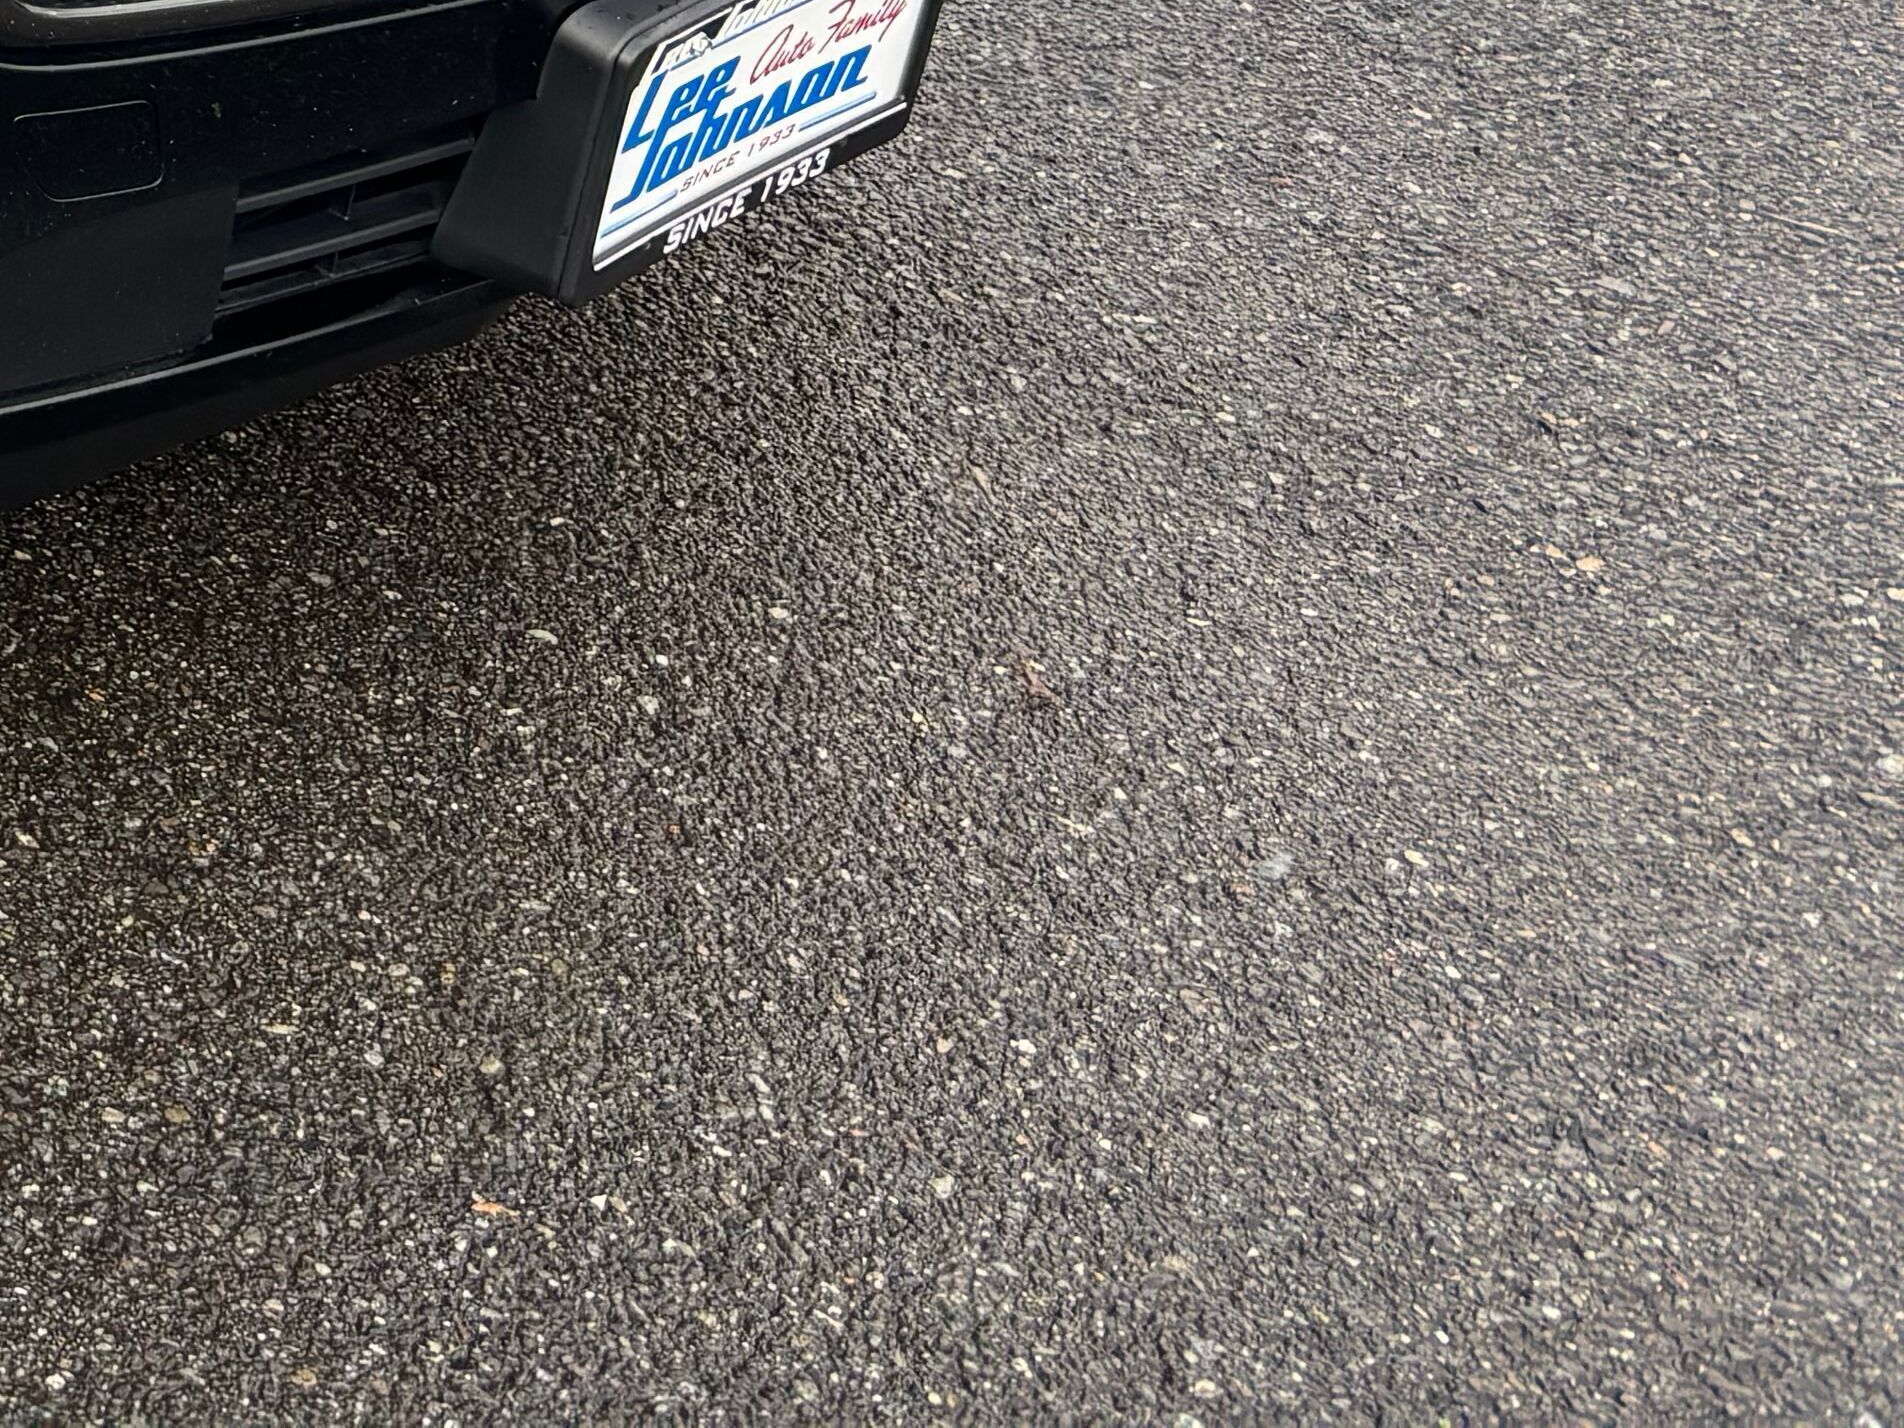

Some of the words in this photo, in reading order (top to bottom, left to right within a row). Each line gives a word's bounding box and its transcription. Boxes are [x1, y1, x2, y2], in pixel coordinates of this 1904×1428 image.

[610, 44, 872, 214] Johnson
[622, 55, 741, 154] Lee
[749, 24, 815, 86] Auto
[663, 187, 752, 254] SINCE
[760, 147, 831, 203] 1933
[679, 150, 741, 193] SINCE
[748, 124, 797, 158] 1933
